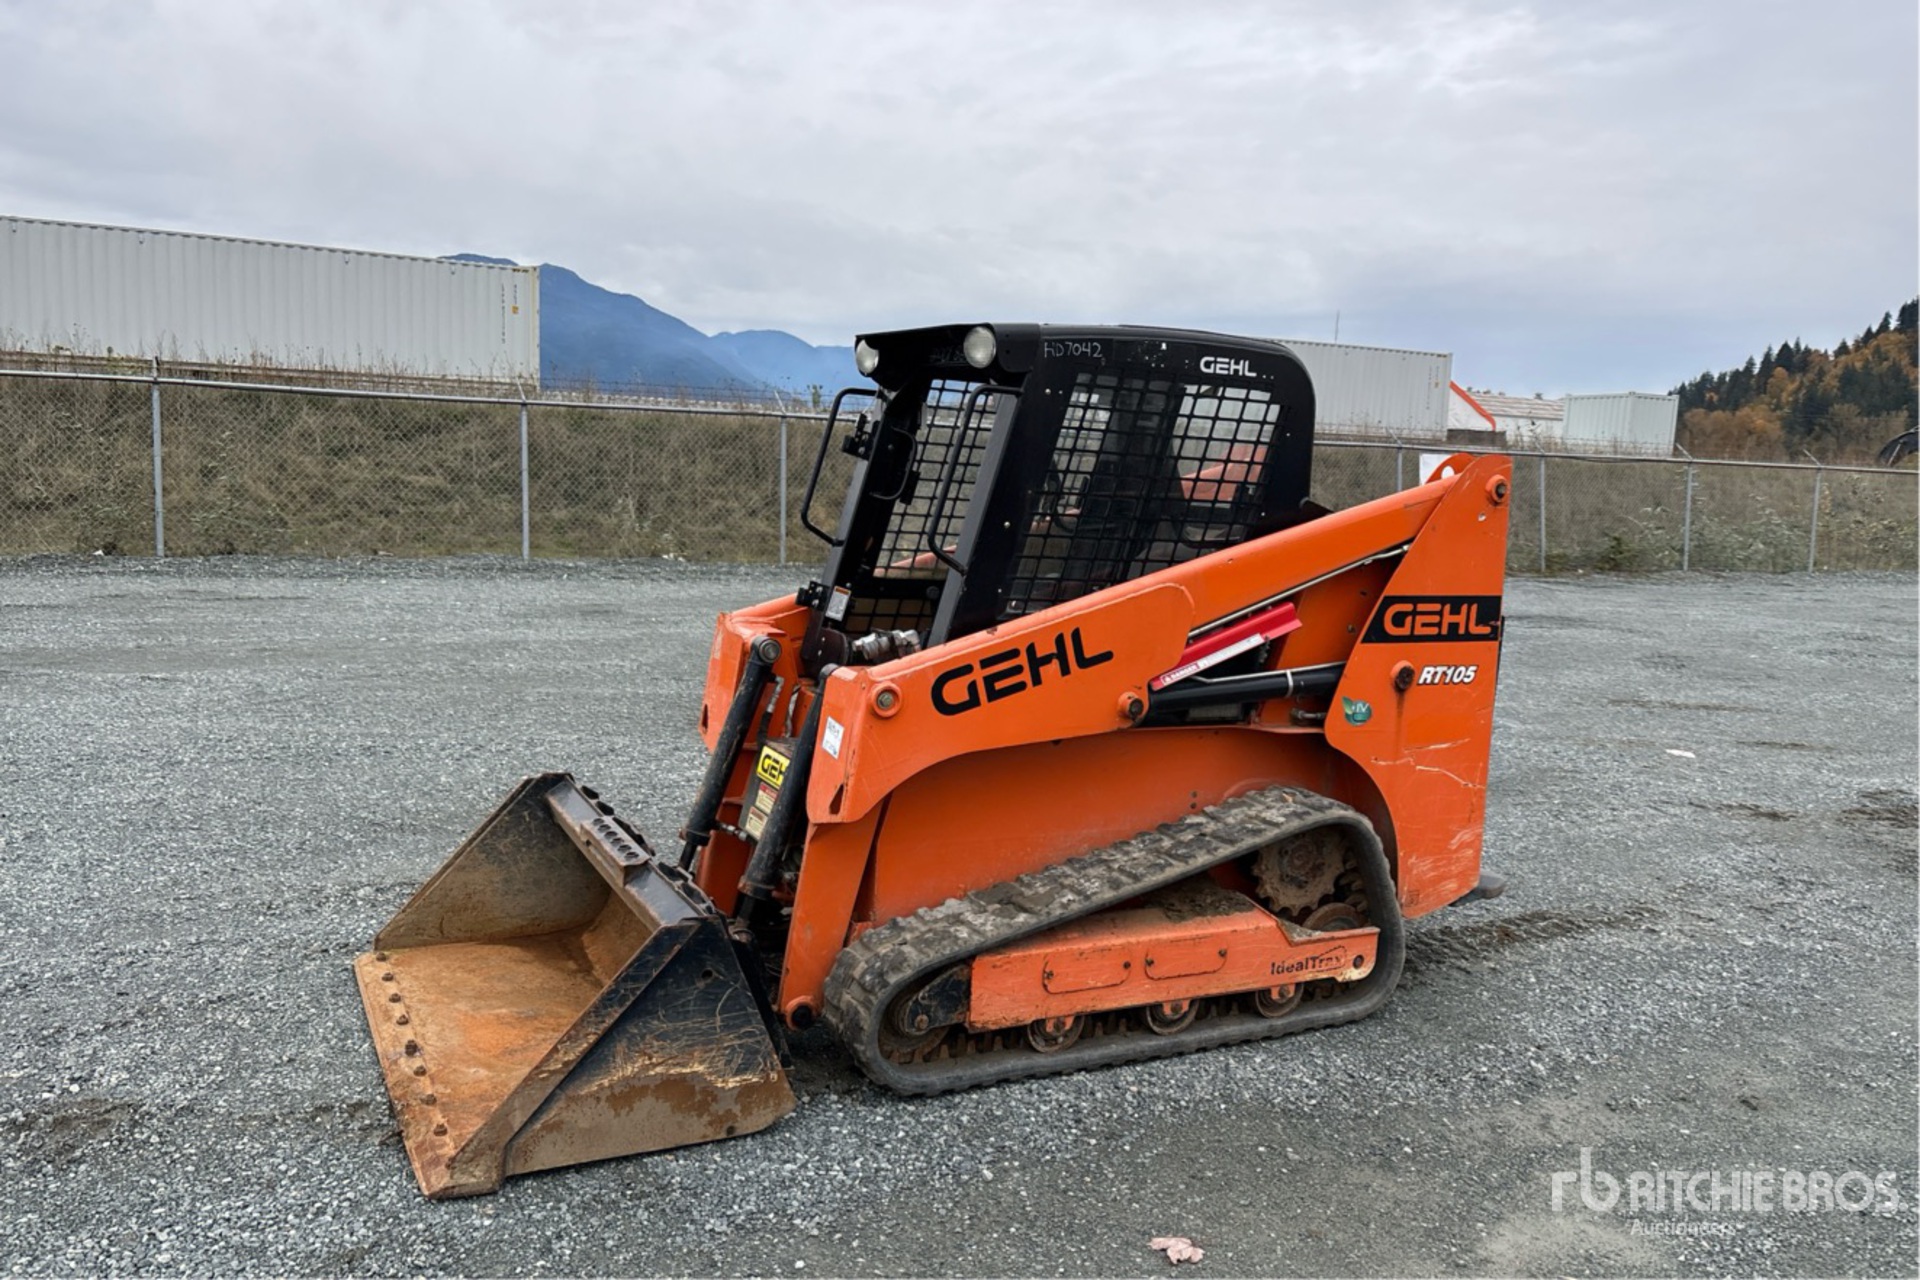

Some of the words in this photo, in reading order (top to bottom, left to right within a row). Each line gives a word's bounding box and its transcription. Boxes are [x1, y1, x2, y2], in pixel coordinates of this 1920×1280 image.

[1044, 341, 1103, 358] HD7042
[1200, 356, 1257, 377] GEHL
[1383, 603, 1492, 636] GEHL
[931, 626, 1114, 716] GEHL
[1417, 665, 1479, 686] RT105
